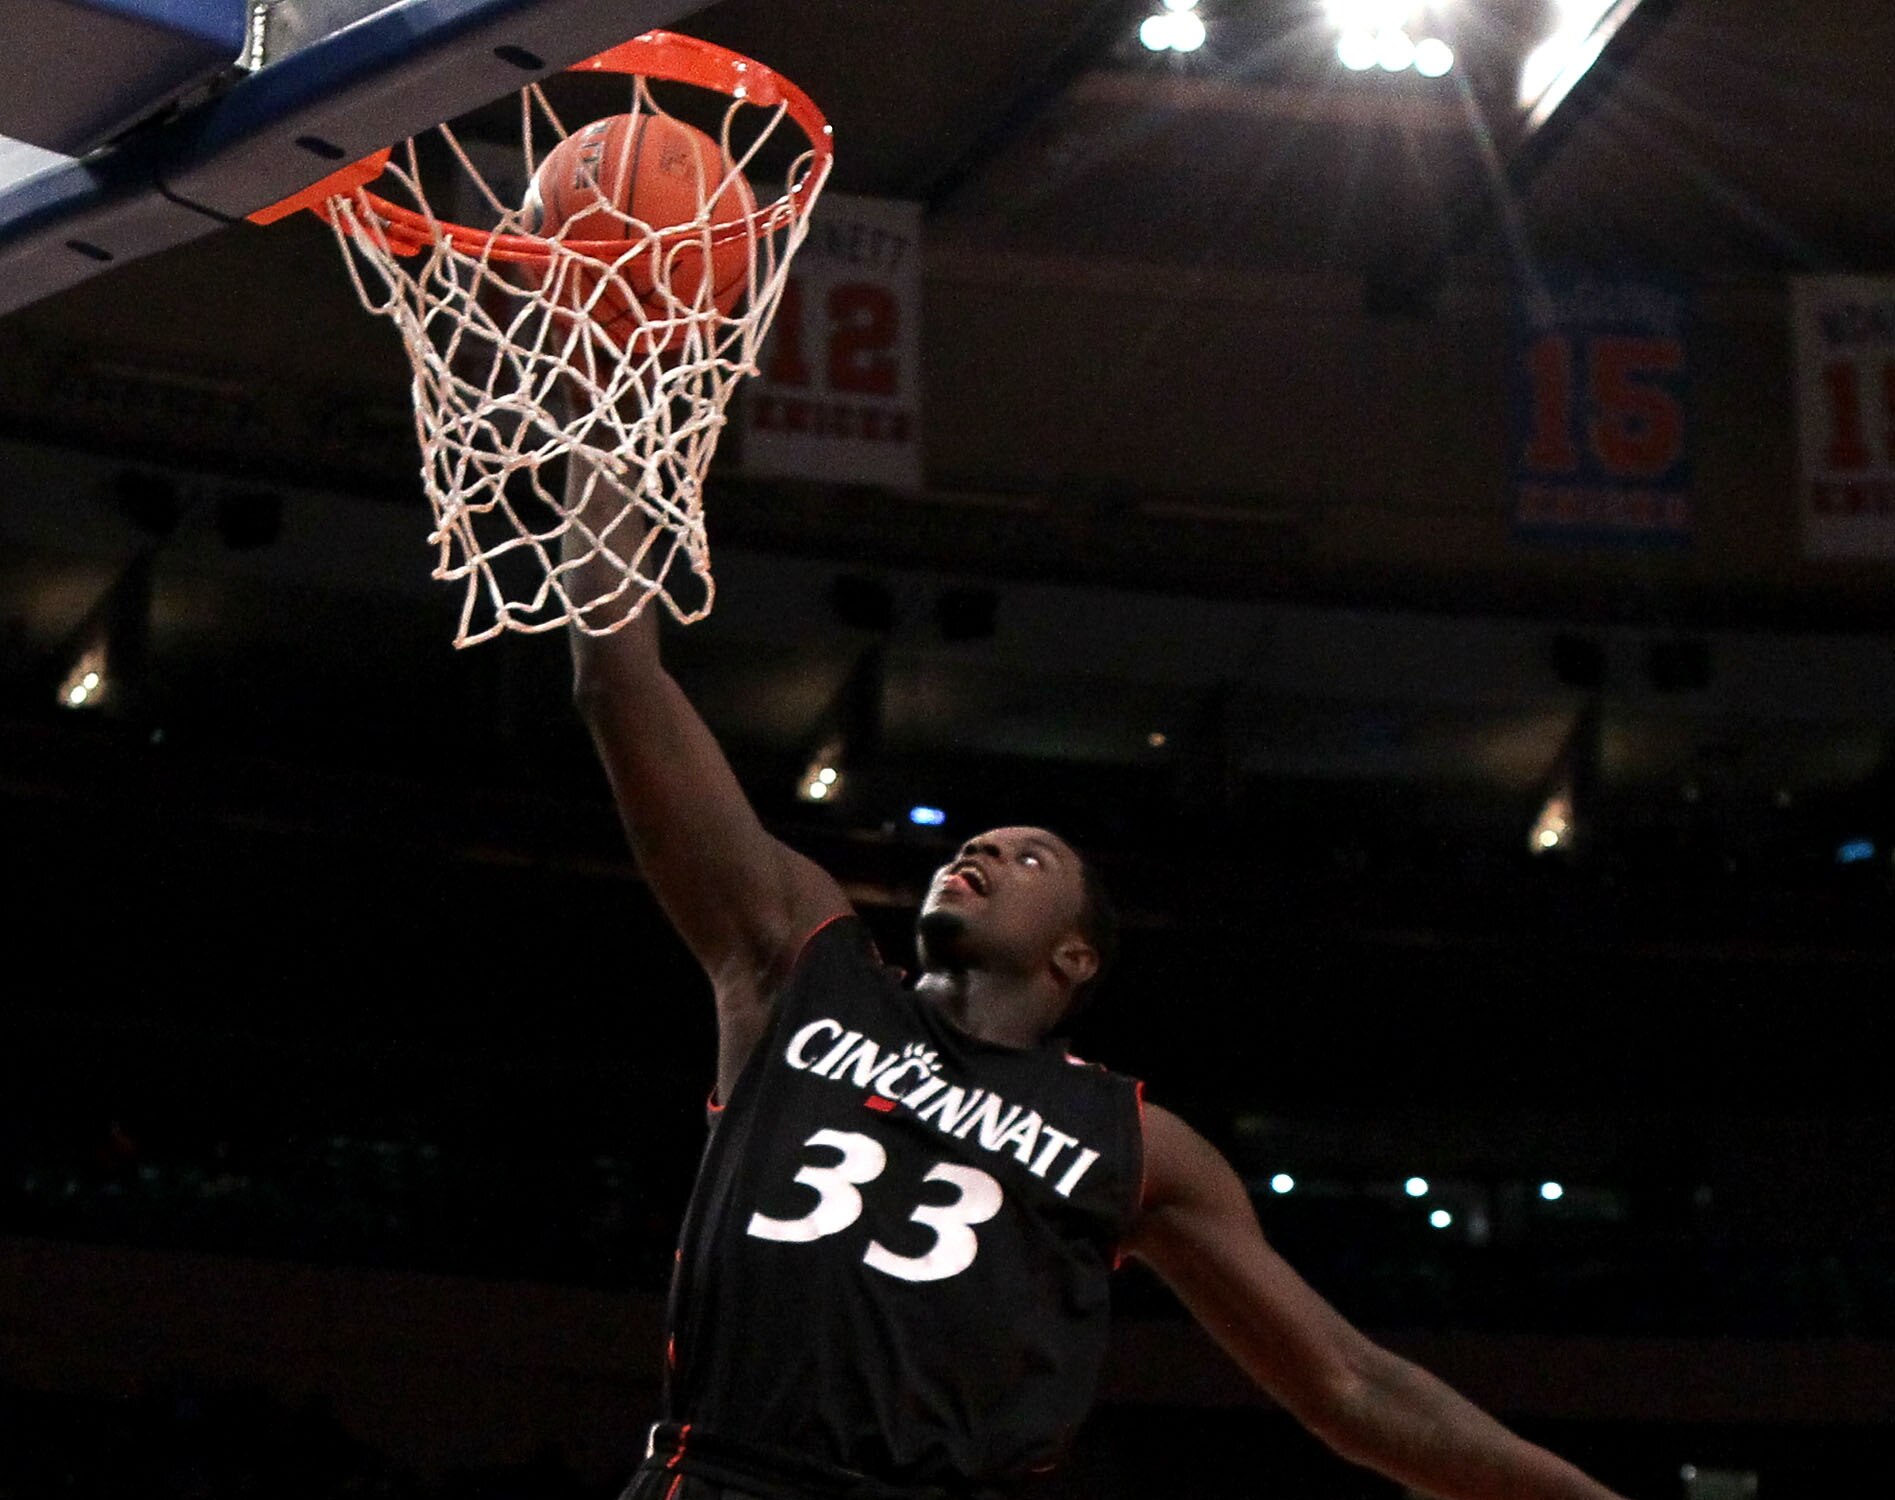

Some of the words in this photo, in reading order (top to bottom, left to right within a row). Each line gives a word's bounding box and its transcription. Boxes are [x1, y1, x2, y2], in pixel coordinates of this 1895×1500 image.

[768, 277, 898, 396] 12
[1525, 333, 1689, 478] 15
[785, 1018, 1101, 1199] CINCINNATI
[747, 1127, 1004, 1283] 33
